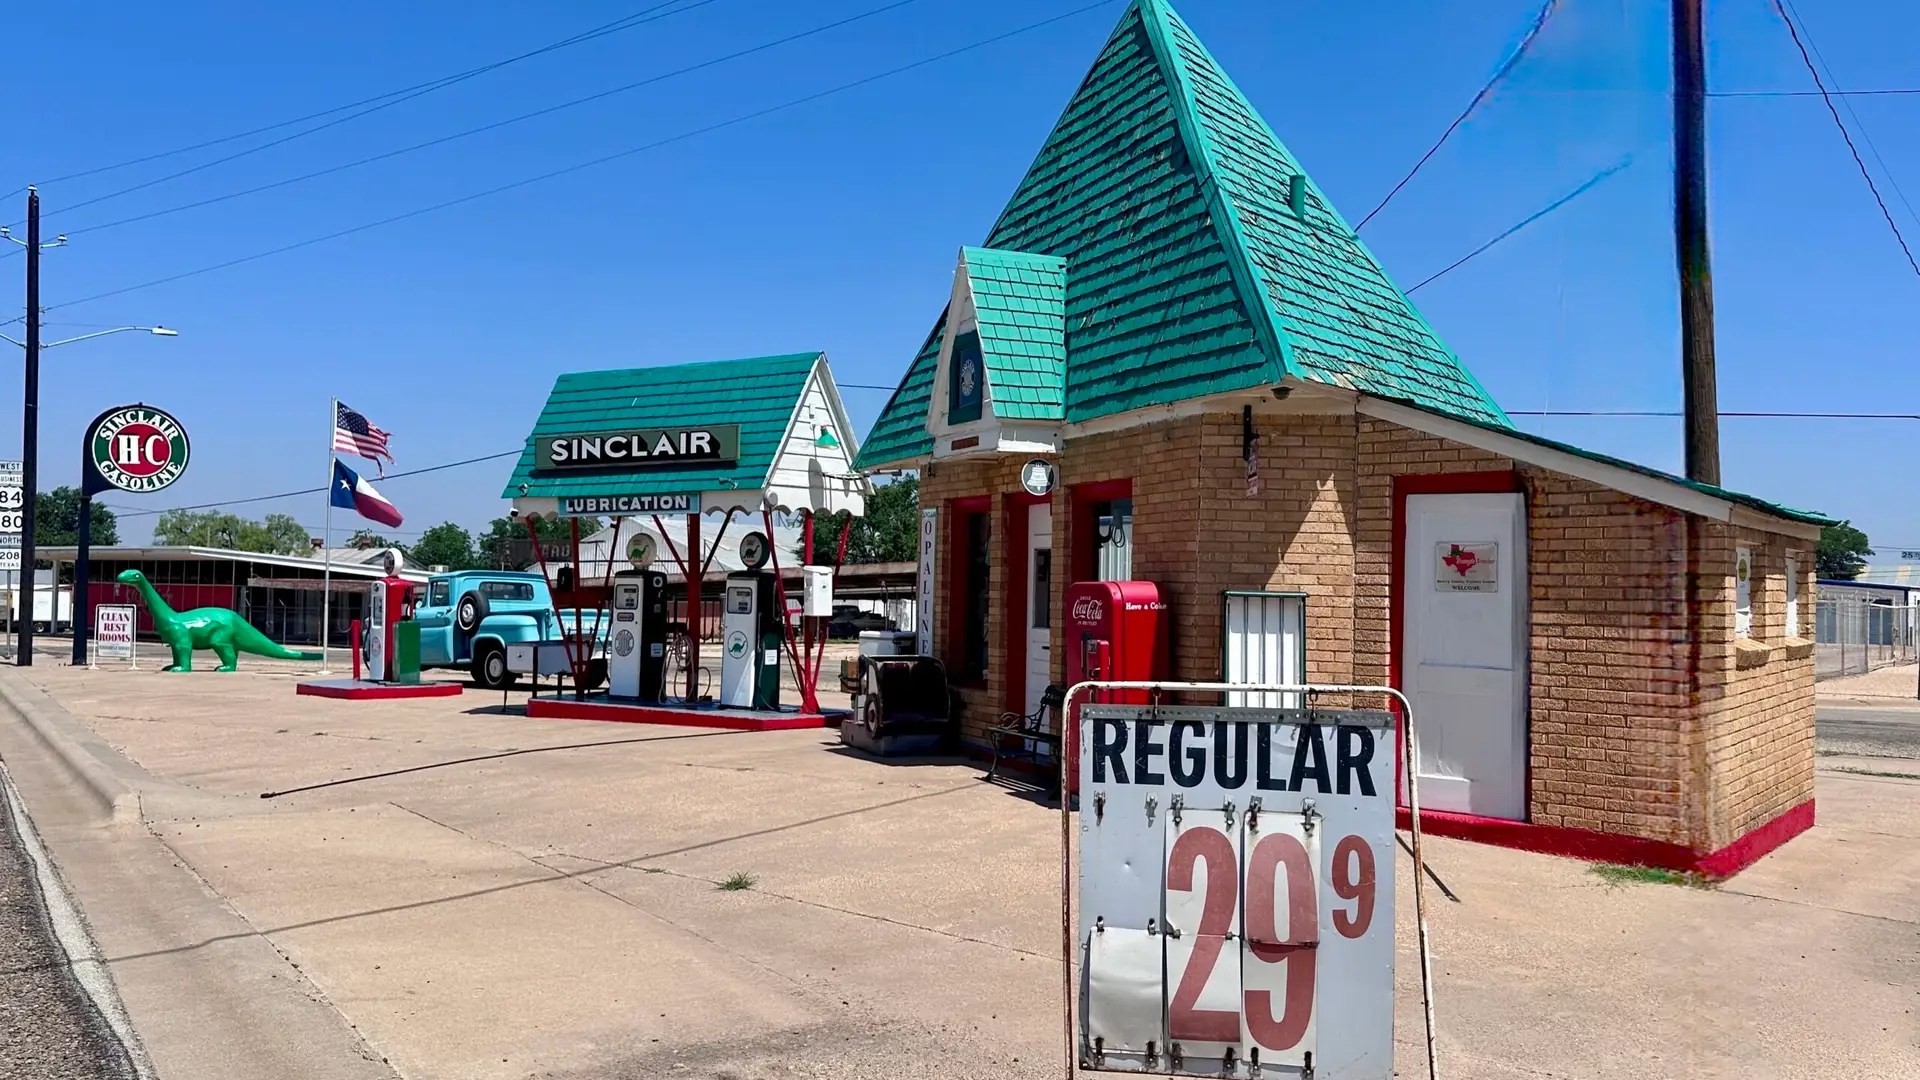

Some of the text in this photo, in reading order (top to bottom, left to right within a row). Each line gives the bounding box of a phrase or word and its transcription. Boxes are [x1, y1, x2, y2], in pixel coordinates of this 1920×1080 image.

[100, 410, 179, 441] SINCLAIR
[551, 431, 712, 462] SINCLAIR
[100, 460, 181, 490] GASOLINE
[565, 495, 688, 512] LUBRICATION
[922, 520, 932, 655] OPALINE
[101, 612, 130, 621] CLEAN
[1125, 602, 1141, 610] Have
[1150, 602, 1167, 610] Coke
[99, 633, 131, 642] ROOMS
[104, 622, 127, 632] REST
[1091, 718, 1378, 797] REGULAR
